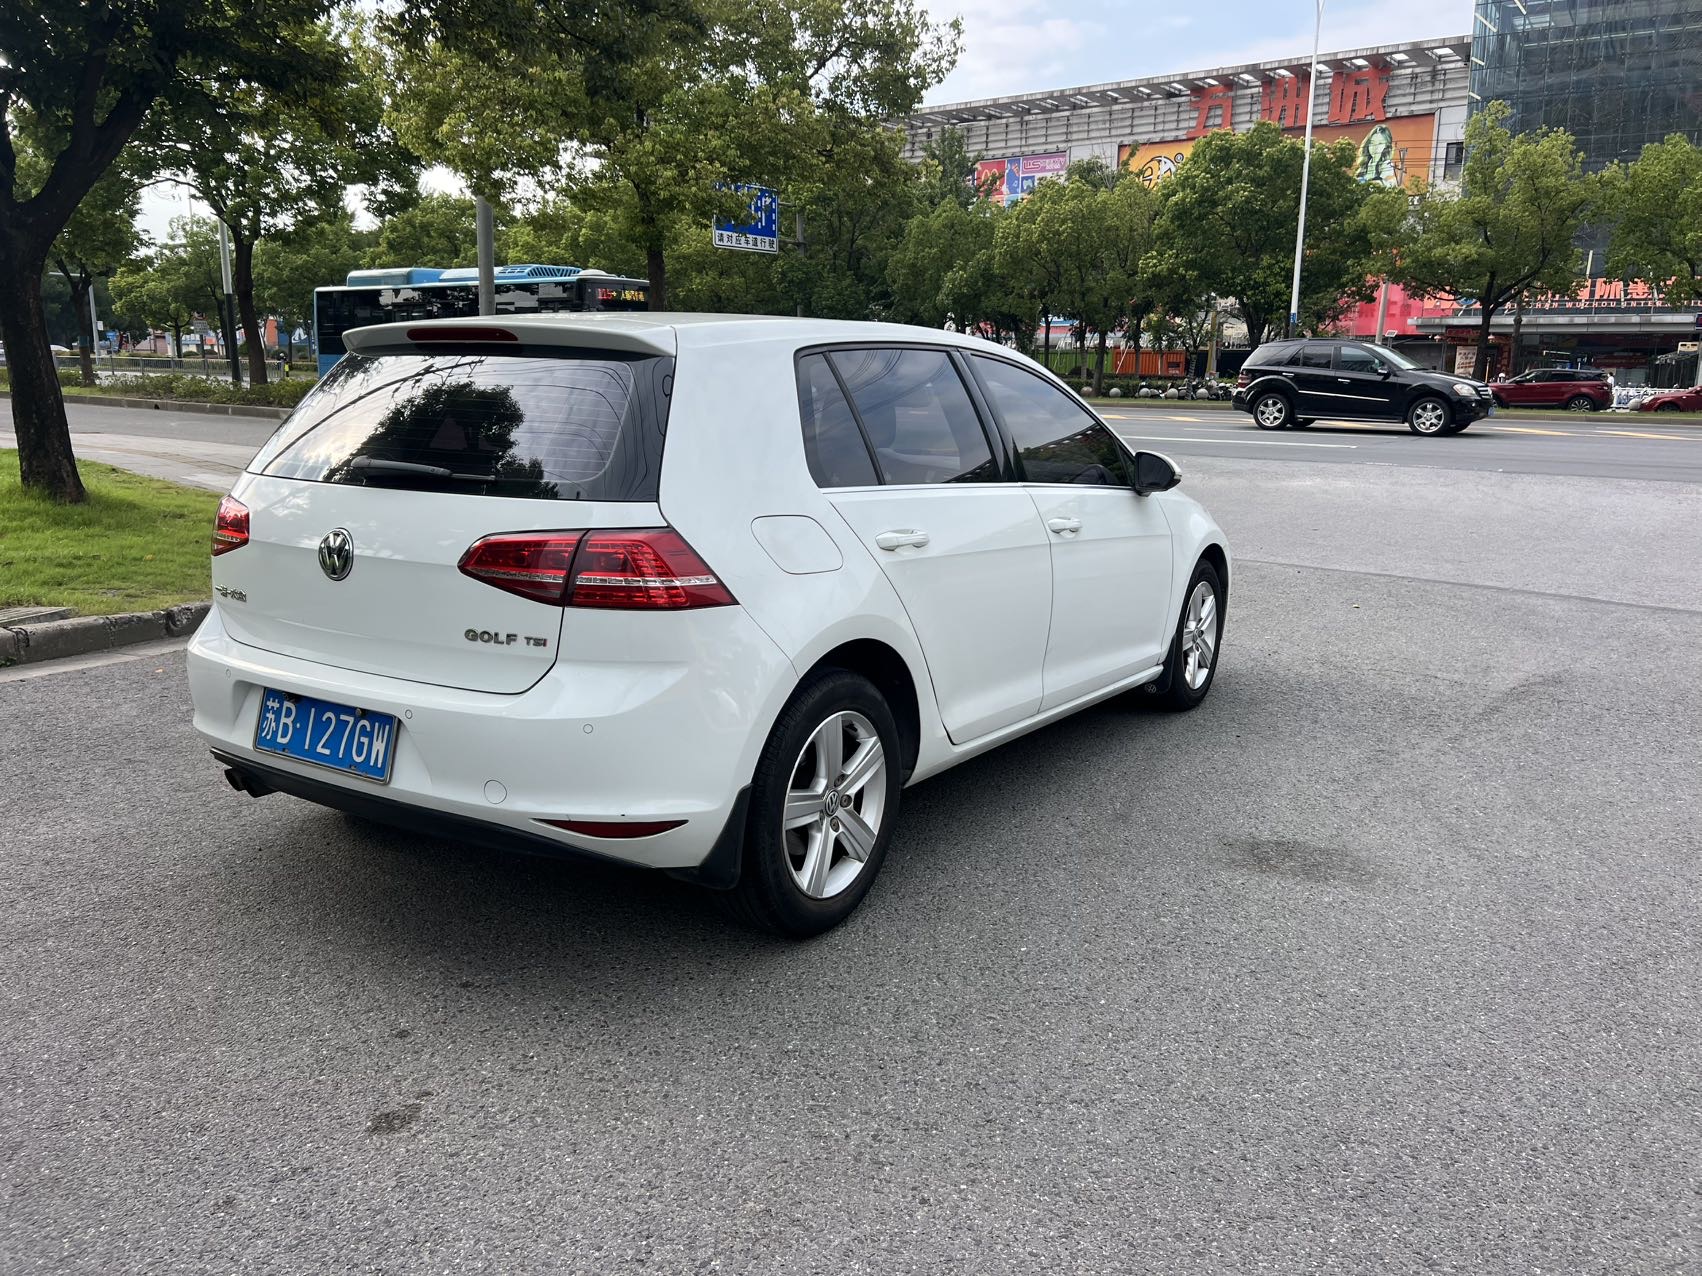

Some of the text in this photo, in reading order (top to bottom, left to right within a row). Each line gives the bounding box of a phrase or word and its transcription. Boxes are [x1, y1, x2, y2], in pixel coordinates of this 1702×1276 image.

[1187, 65, 1392, 139] 五洲城
[717, 232, 776, 250] 请对应车道行驶
[464, 628, 548, 648] GOLF TSI
